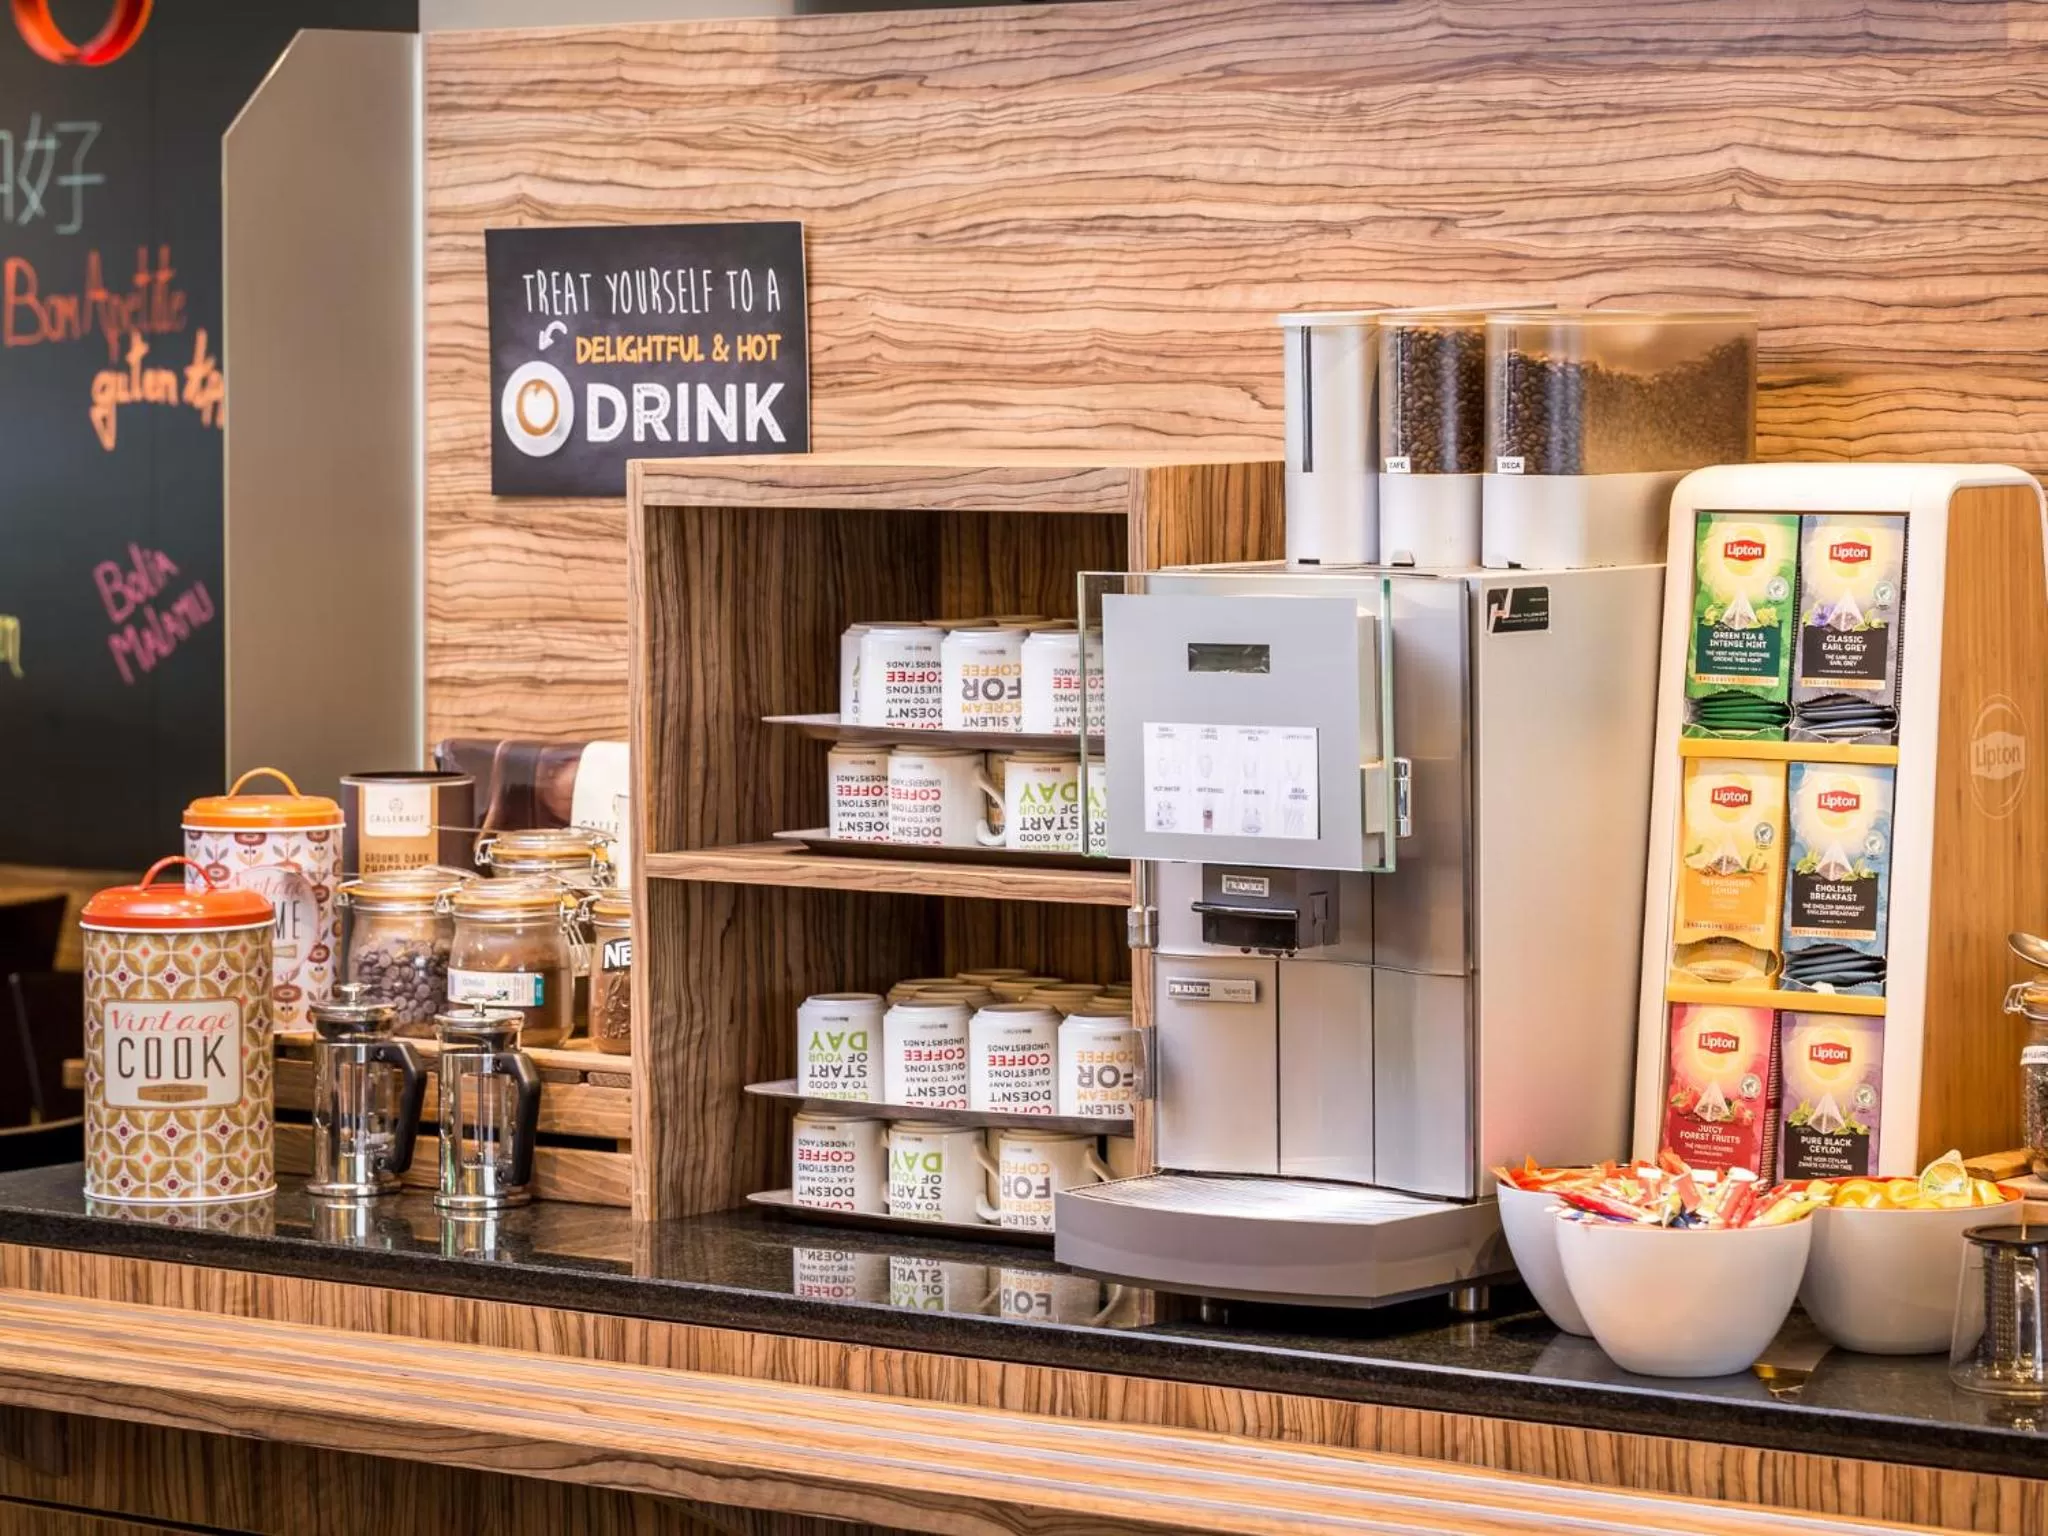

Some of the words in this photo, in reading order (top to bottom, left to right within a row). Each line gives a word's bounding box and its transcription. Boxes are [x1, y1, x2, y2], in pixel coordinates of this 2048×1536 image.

[523, 269, 591, 316] TREAT
[605, 267, 713, 315] YOURSELF
[726, 268, 753, 312] TO
[767, 268, 780, 312] A
[575, 334, 704, 364] DELIGHTFUL
[712, 333, 729, 363] &
[737, 334, 782, 363] HOT
[586, 382, 787, 443] DRINK
[1501, 461, 1521, 470] DECA
[1726, 543, 1763, 557] Lipton
[1832, 545, 1869, 559] Lipton
[1712, 631, 1740, 640] GREEN
[1742, 632, 1757, 641] TEA
[1826, 635, 1864, 644] CLASSIC
[1709, 639, 1744, 648] INTENSE
[1746, 641, 1767, 649] MINT
[1822, 643, 1842, 651] EARL
[1844, 644, 1867, 652] GREY
[962, 664, 1021, 676] COFFEE
[962, 678, 1021, 701] FOR
[963, 716, 1009, 728] SILENT
[1976, 743, 2021, 773] Lipton
[1020, 781, 1079, 803] DAY
[1713, 790, 1749, 804] Lipton
[1820, 794, 1857, 809] Lipton
[1020, 817, 1079, 831] START
[1020, 833, 1052, 842] GOOD
[405, 853, 431, 864] DARK
[1815, 884, 1853, 892] ENGLISH
[1810, 892, 1857, 901] BREAKFAST
[604, 944, 631, 969] NE
[110, 1009, 235, 1034] Vintage
[809, 1031, 868, 1051] DAY
[903, 1037, 965, 1047] UNDERSTANDS
[987, 1042, 1050, 1052] UNDERSTANDS
[1701, 1035, 1737, 1049] Lipton
[118, 1035, 227, 1080] COOK
[809, 1053, 843, 1063] YOUR
[847, 1053, 868, 1063] OF
[903, 1049, 965, 1062] COFFEE
[1811, 1046, 1849, 1060] Lipton
[988, 1053, 1051, 1066] COFFEE
[809, 1064, 868, 1078] START
[904, 1063, 966, 1073] QUESTIONS
[988, 1067, 1051, 1078] QUESTIONS
[809, 1081, 838, 1089] GOOD
[841, 1081, 848, 1089] A
[852, 1080, 868, 1089] TO
[931, 1075, 949, 1083] TOO
[1014, 1080, 1033, 1088] TOO
[1034, 1079, 1051, 1087] ASK
[905, 1085, 967, 1097] DOESN'T
[990, 1089, 1052, 1103] DOESN'T
[1077, 1088, 1131, 1101] CREAM
[1079, 1103, 1125, 1116] SILENT
[1698, 1125, 1723, 1134] JUICY
[798, 1138, 856, 1147] UNDERSTANDS
[1680, 1131, 1710, 1141] FOREST
[1711, 1134, 1742, 1145] FRUITS
[1801, 1135, 1822, 1145] PURE
[1824, 1137, 1852, 1147] BLACK
[1809, 1145, 1842, 1154] CEYLON
[798, 1149, 856, 1163] COFFEE
[892, 1150, 943, 1173] DAY
[798, 1163, 856, 1173] QUESTIONS
[921, 1175, 942, 1185] OF
[799, 1187, 856, 1198] DOESN'T
[892, 1184, 942, 1200] START
[1002, 1176, 1051, 1199] FOR
[915, 1202, 922, 1210] A
[925, 1202, 942, 1211] TO
[1041, 1215, 1051, 1226] A
